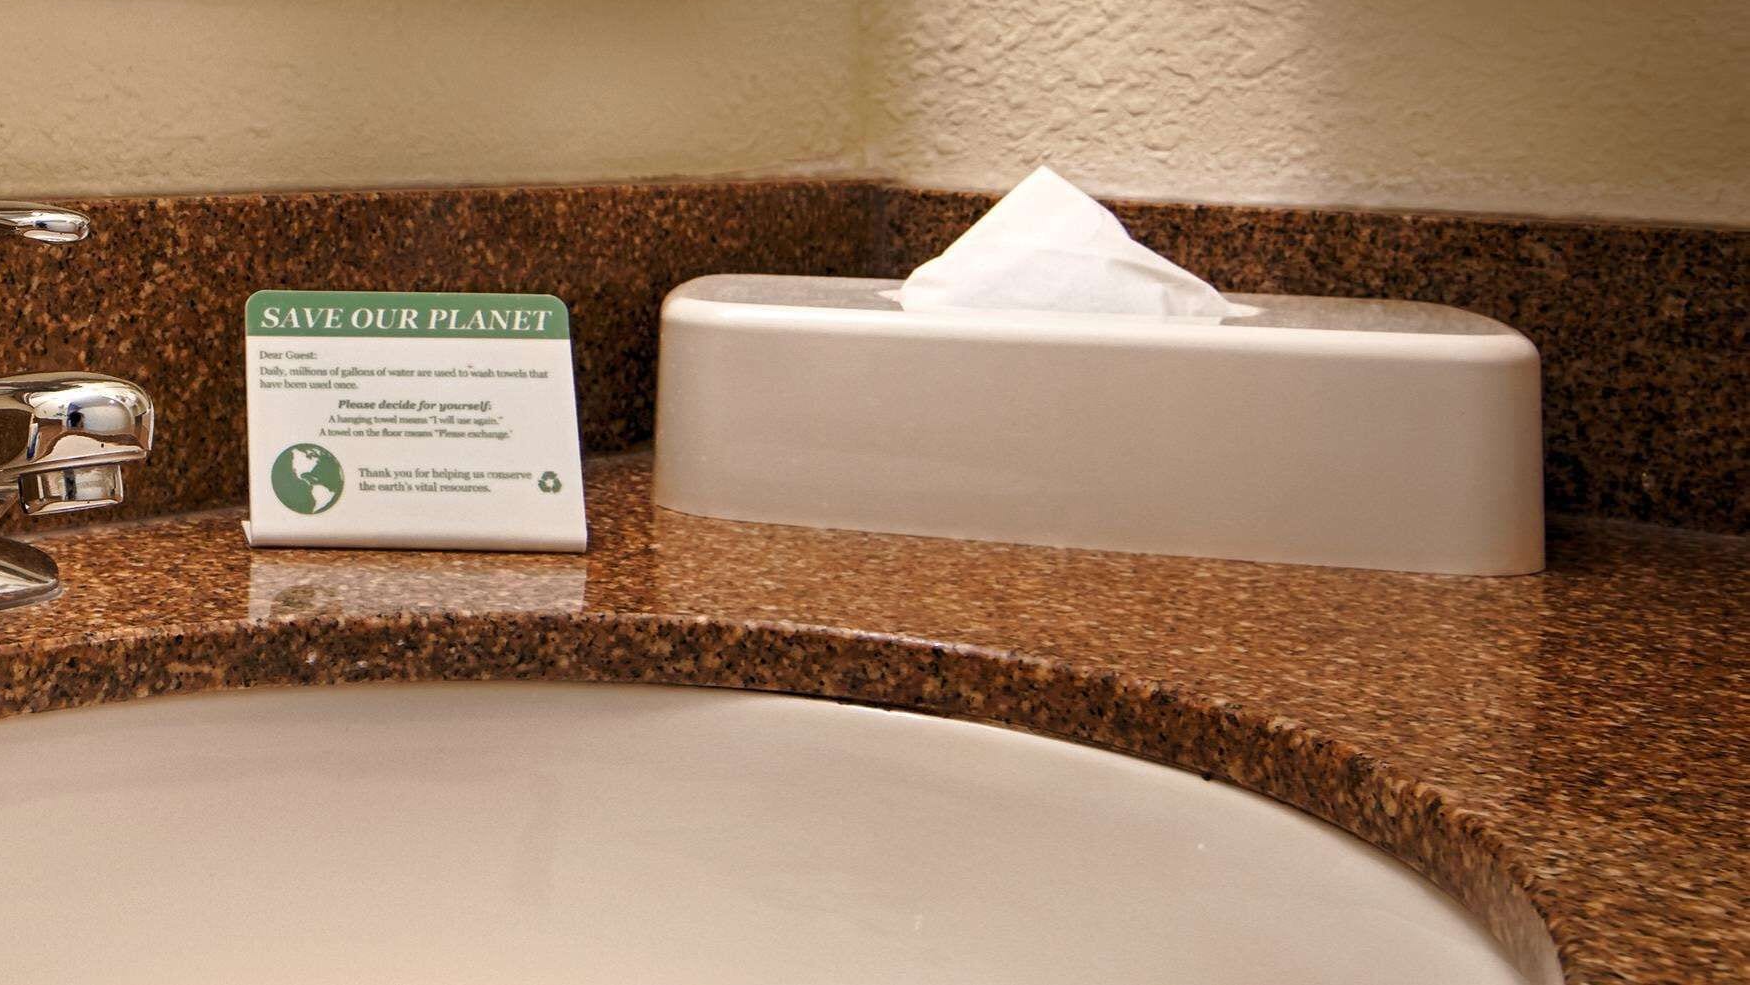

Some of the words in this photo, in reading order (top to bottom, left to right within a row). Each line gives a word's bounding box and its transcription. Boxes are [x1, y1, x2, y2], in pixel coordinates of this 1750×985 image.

[261, 307, 343, 328] SAVE
[352, 309, 418, 329] OUR
[427, 309, 552, 331] PLANET
[260, 351, 282, 359] Dear
[286, 351, 317, 360] Guest:
[260, 366, 287, 377] Daily,
[290, 366, 327, 376] millions
[330, 367, 339, 376] of
[341, 367, 375, 378] gallons
[377, 367, 386, 376] of
[388, 369, 414, 377] water
[434, 369, 456, 377] used
[458, 369, 468, 377] to
[470, 369, 495, 378] wash
[496, 369, 527, 378] towels
[529, 369, 548, 378] that
[260, 379, 282, 389] have
[284, 380, 306, 389] been
[309, 380, 331, 389] used
[338, 400, 376, 409] Please
[379, 400, 416, 409] decide
[417, 401, 436, 411] for
[439, 401, 492, 411] yourself:
[337, 416, 372, 425] hanging
[440, 416, 454, 424] will
[382, 429, 401, 437] floor
[358, 468, 390, 478] Thank
[394, 471, 412, 480] you
[415, 468, 428, 478] for
[433, 469, 470, 480] helping
[487, 470, 532, 479] conserve
[359, 483, 374, 491] the
[378, 483, 412, 491] earth's
[415, 483, 437, 492] vital
